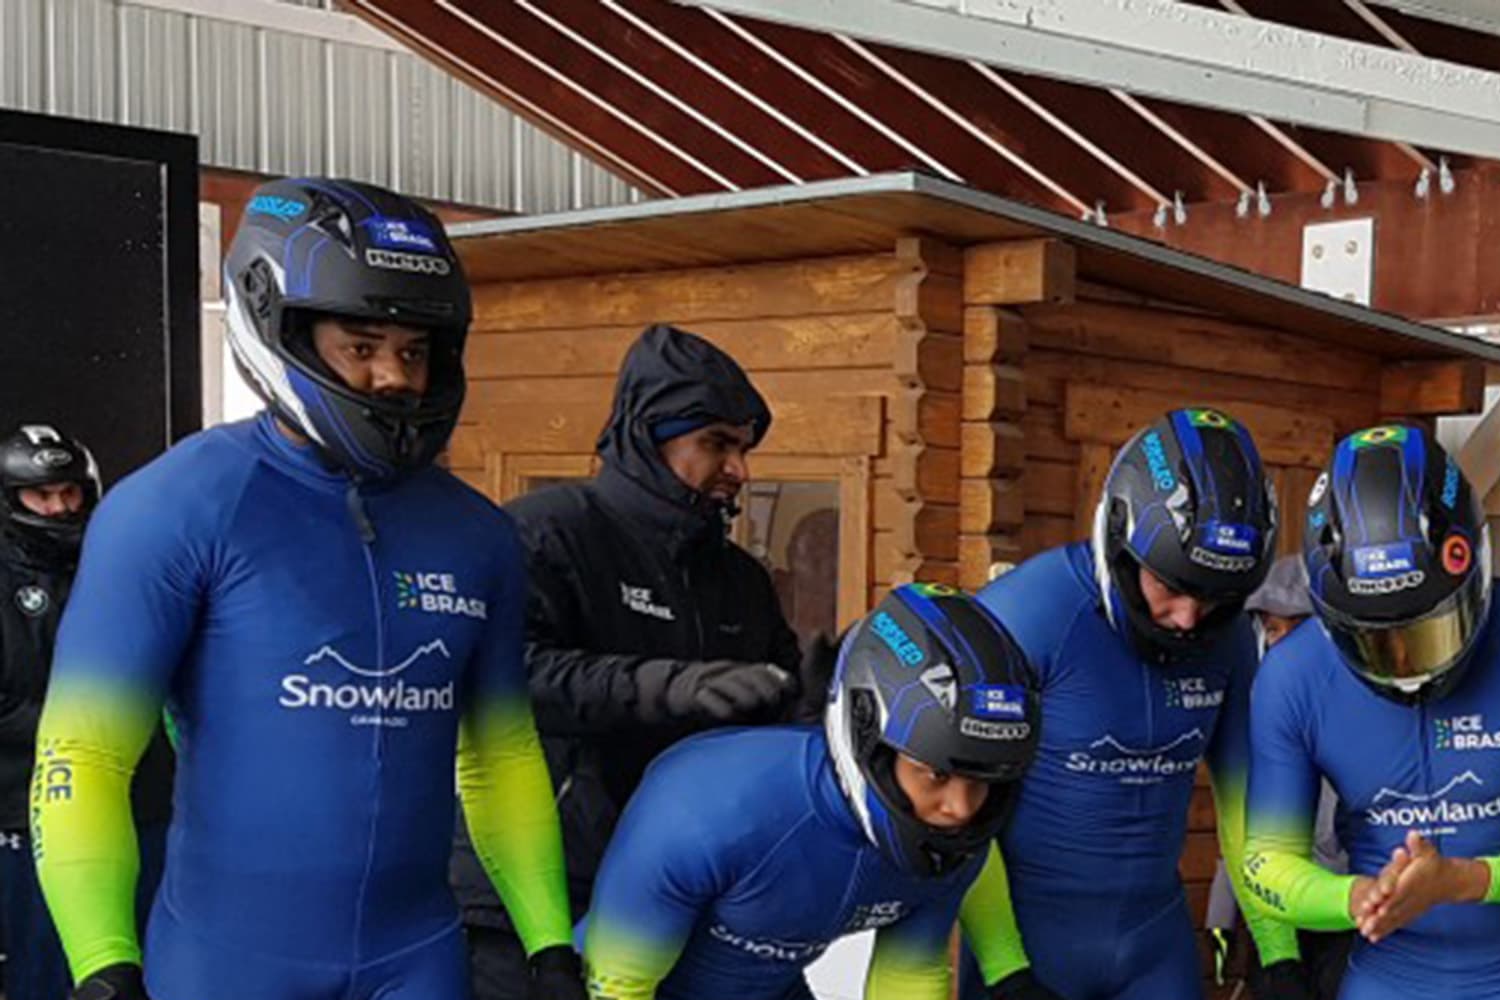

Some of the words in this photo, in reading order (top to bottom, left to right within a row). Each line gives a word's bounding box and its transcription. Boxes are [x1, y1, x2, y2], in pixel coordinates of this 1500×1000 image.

[416, 571, 456, 593] ICE
[279, 674, 454, 711] Snowland
[1451, 714, 1484, 732] ICE
[46, 758, 73, 804] ICE
